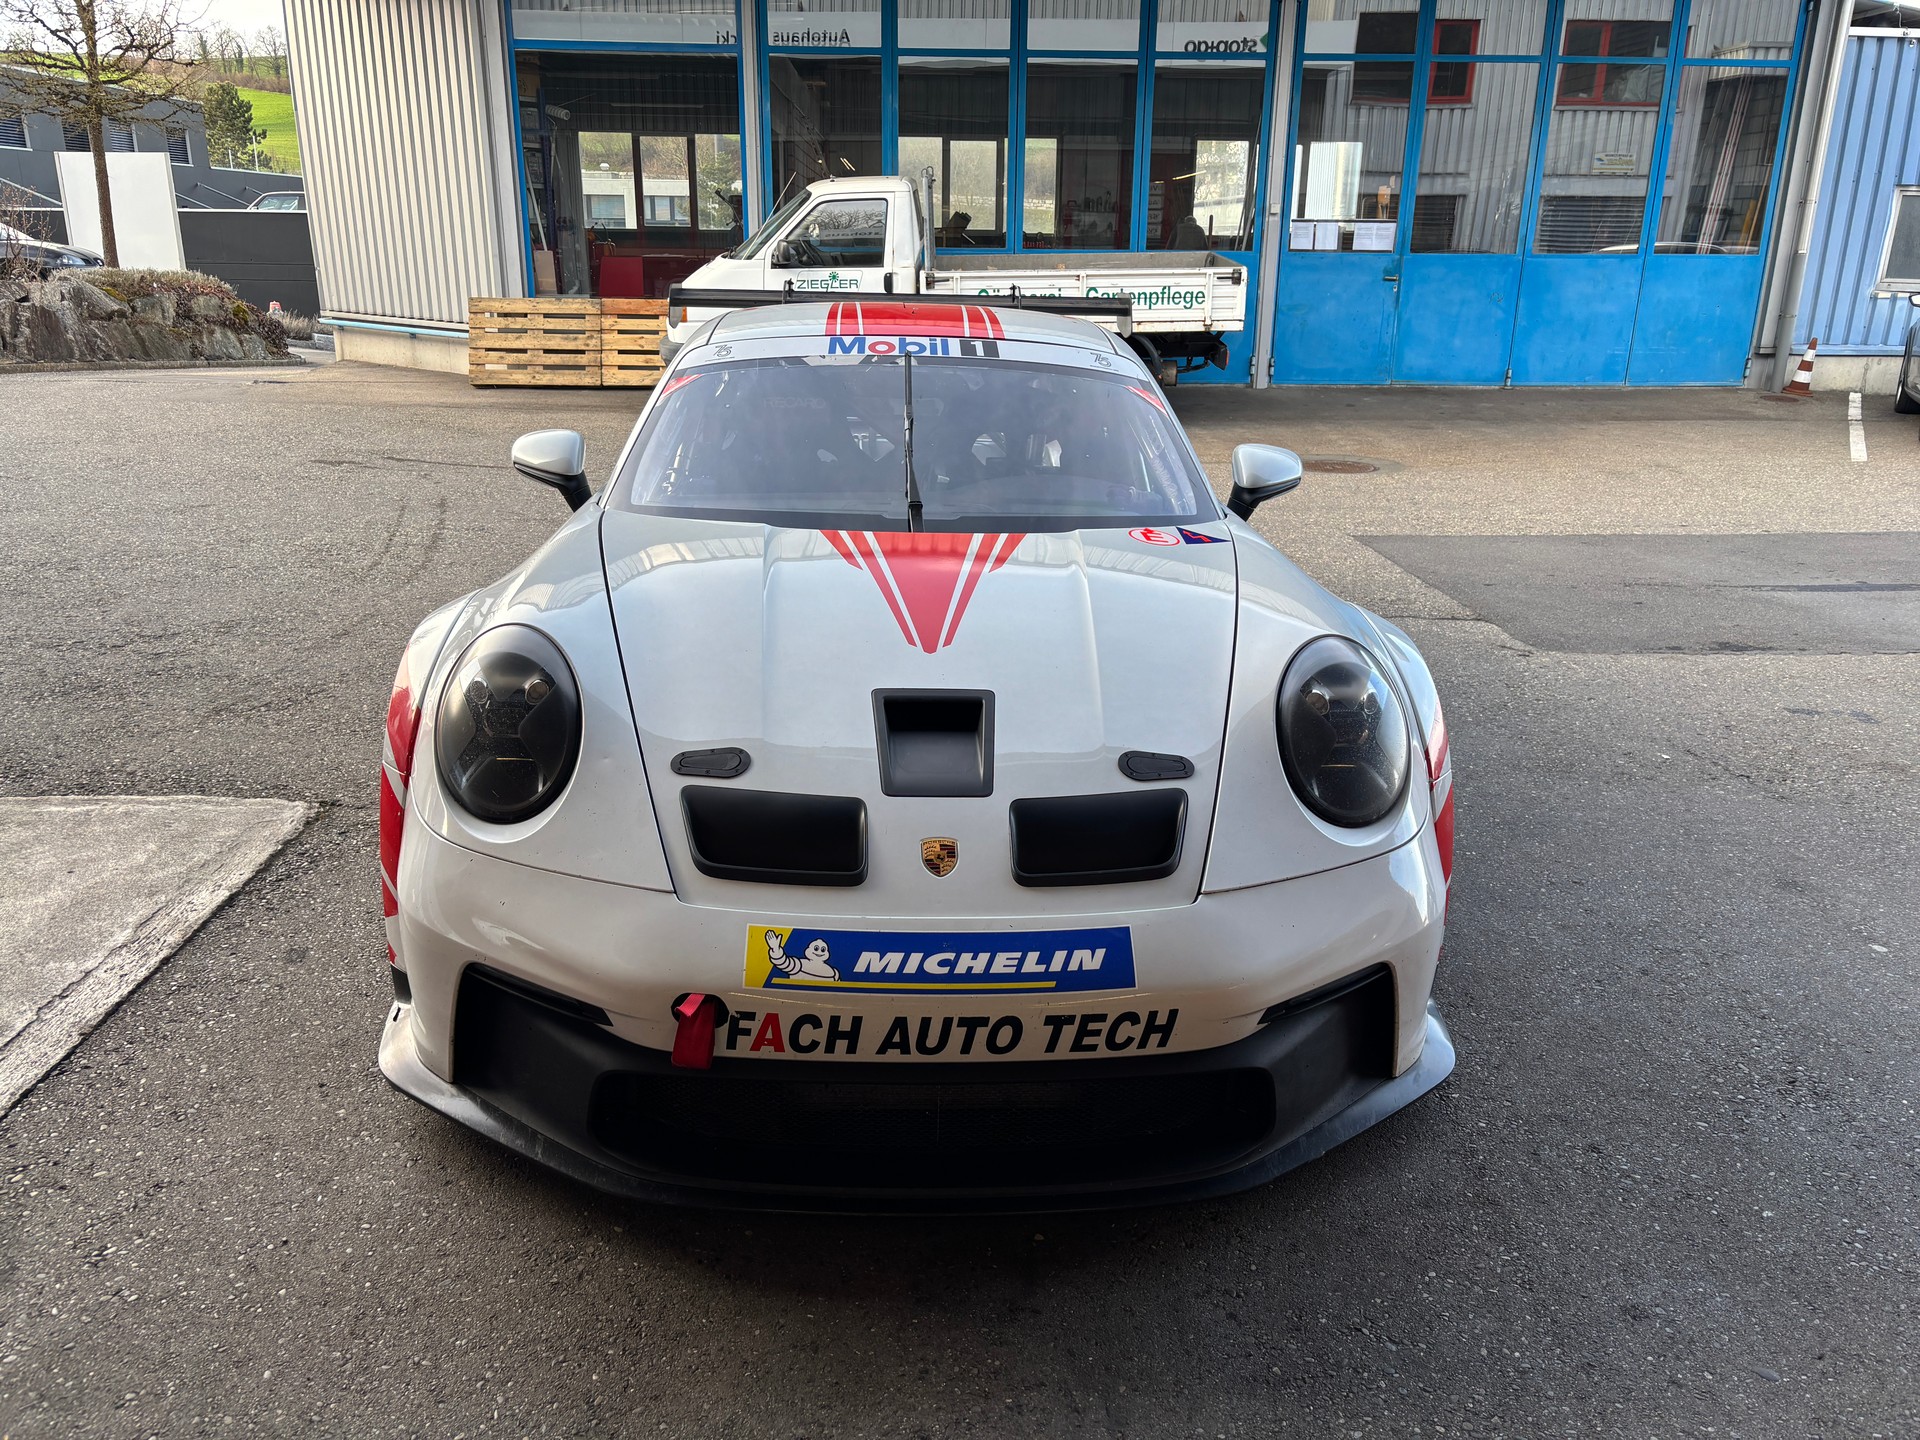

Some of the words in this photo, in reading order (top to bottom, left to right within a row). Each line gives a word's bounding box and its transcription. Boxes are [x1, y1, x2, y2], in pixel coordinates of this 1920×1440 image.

[797, 279, 858, 292] ZIEGLER
[1086, 286, 1205, 309] Genpflege
[828, 336, 949, 355] Mobil
[853, 948, 1106, 975] MICHELIN
[726, 1010, 862, 1055] FACH
[876, 1013, 1024, 1056] AUTO
[1043, 1008, 1180, 1053] TECH
